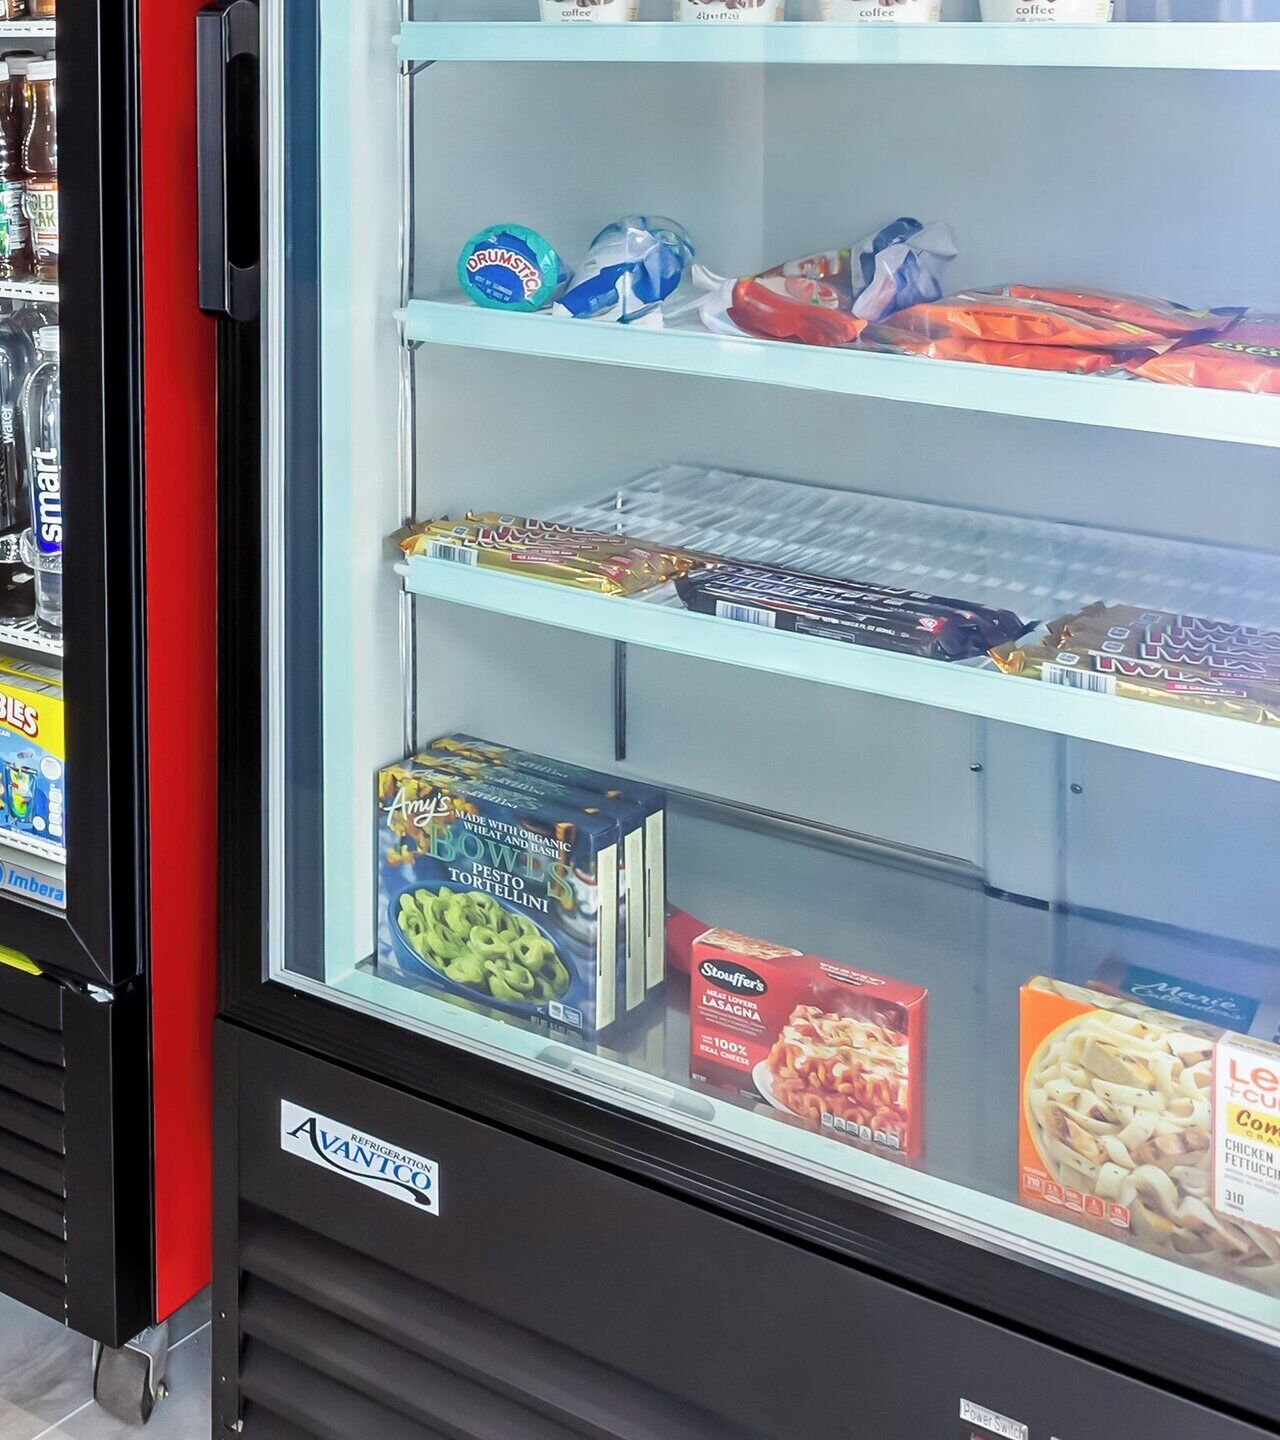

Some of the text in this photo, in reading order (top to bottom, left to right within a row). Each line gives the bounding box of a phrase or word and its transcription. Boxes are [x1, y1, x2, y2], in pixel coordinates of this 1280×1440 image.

[561, 8, 592, 18] coffee
[860, 8, 895, 18] coffee
[1016, 5, 1056, 16] coffee
[32, 447, 62, 543] smart
[383, 787, 450, 827] Amy's
[455, 809, 572, 852] MADE WITH ORGANIC
[463, 821, 562, 860] WHEAT AND BASIL
[426, 823, 573, 903] BOWLS
[472, 861, 525, 890] PESTO
[7, 868, 64, 903] Imbera
[448, 867, 549, 914] TORTELLINI
[701, 962, 765, 992] Stouffer's
[702, 995, 762, 1022] LASAGNA
[699, 1044, 750, 1066] REAL CHEESE
[714, 1037, 748, 1056] 100%
[287, 1117, 432, 1194] AVANTCO
[351, 1133, 432, 1173] REFRIGERATION
[1225, 1138, 1274, 1164] CHICKEN
[1225, 1152, 1280, 1181] FETTUCCI
[1225, 1189, 1244, 1205] 310
[964, 1403, 1025, 1440] Power Switch
